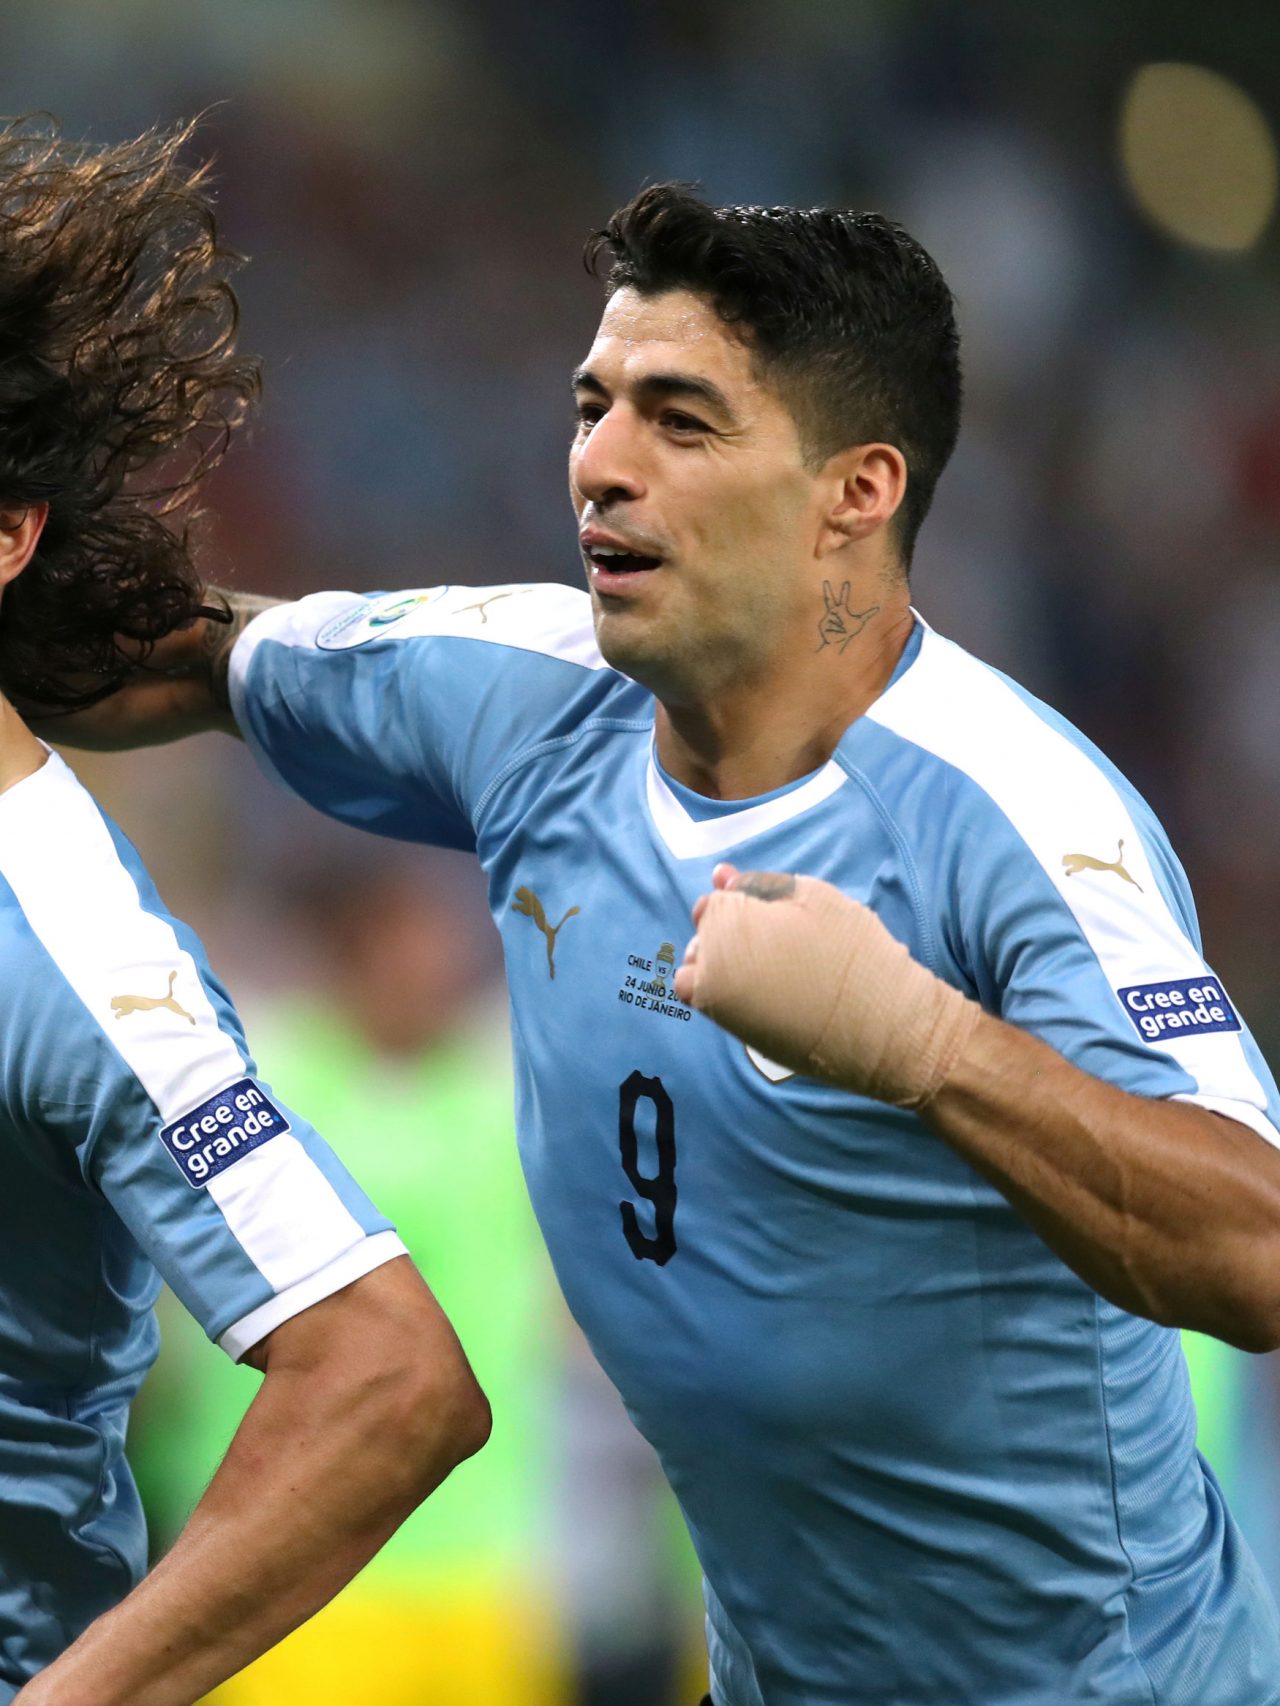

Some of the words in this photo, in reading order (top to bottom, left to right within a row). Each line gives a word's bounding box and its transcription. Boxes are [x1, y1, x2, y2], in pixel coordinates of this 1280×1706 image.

[627, 954, 652, 972] CHILE
[624, 975, 637, 989] 24
[637, 980, 666, 998] JUNIO
[1127, 991, 1186, 1012] Cree
[1188, 985, 1220, 1003] en
[618, 989, 634, 1004] RIO
[634, 995, 648, 1009] DE
[647, 1000, 692, 1022] JANEIRO
[171, 1105, 234, 1151] Cree
[235, 1088, 264, 1111] en
[619, 1069, 677, 1267] 9
